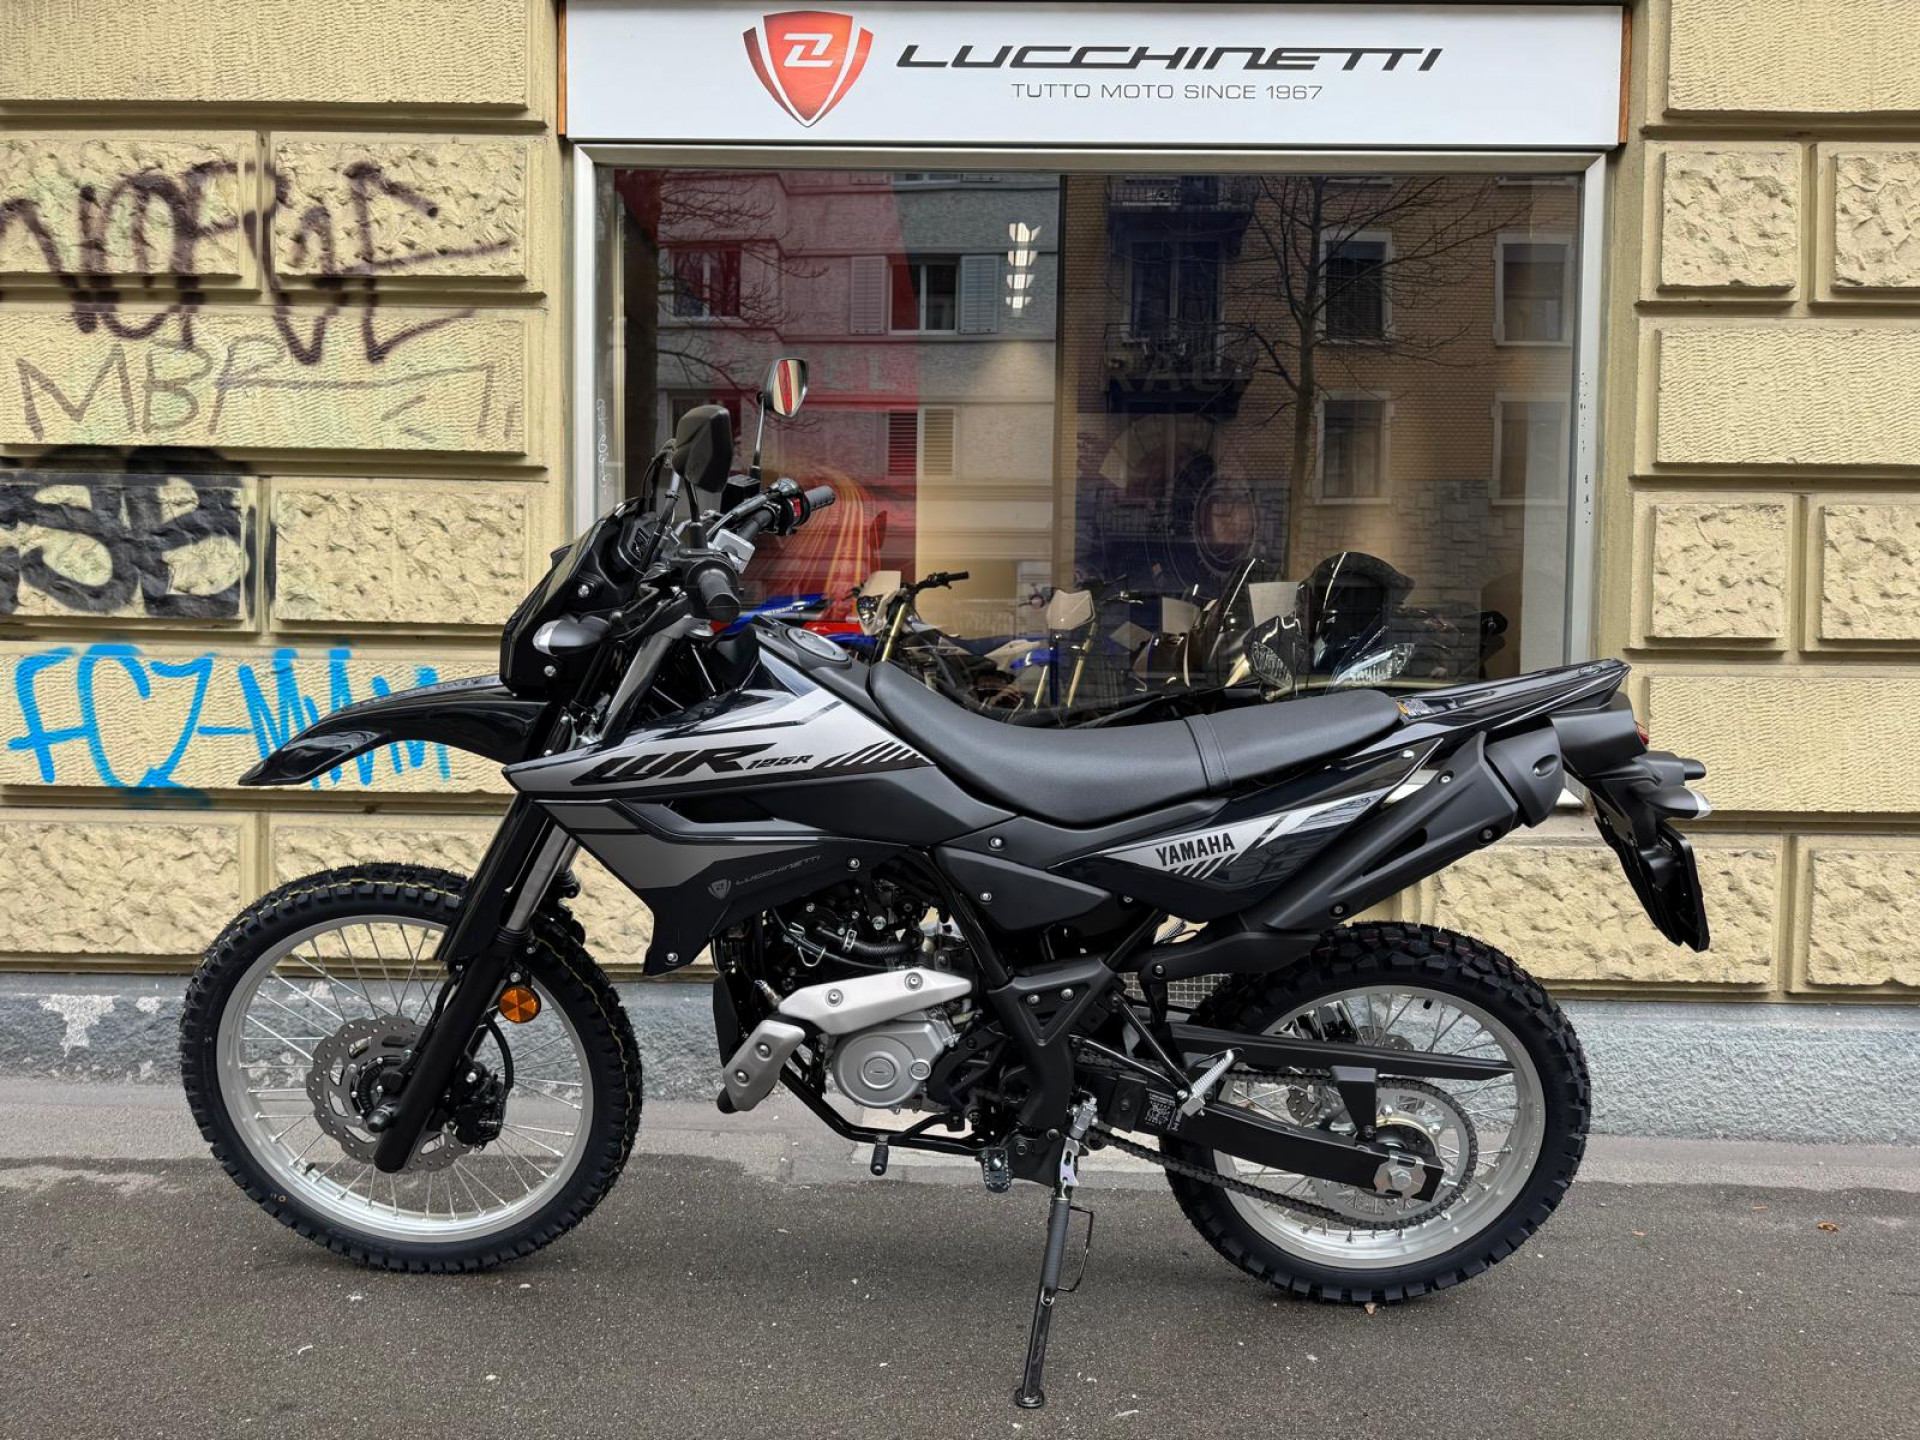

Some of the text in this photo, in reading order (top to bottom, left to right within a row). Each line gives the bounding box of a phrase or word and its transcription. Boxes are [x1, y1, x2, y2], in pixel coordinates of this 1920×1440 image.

[896, 45, 1443, 72] LUCCHINETTI
[1011, 83, 1323, 99] TUTTO MOTO SINCE 1967
[570, 743, 814, 786] WR 125R
[1155, 832, 1236, 867] YAMAHA
